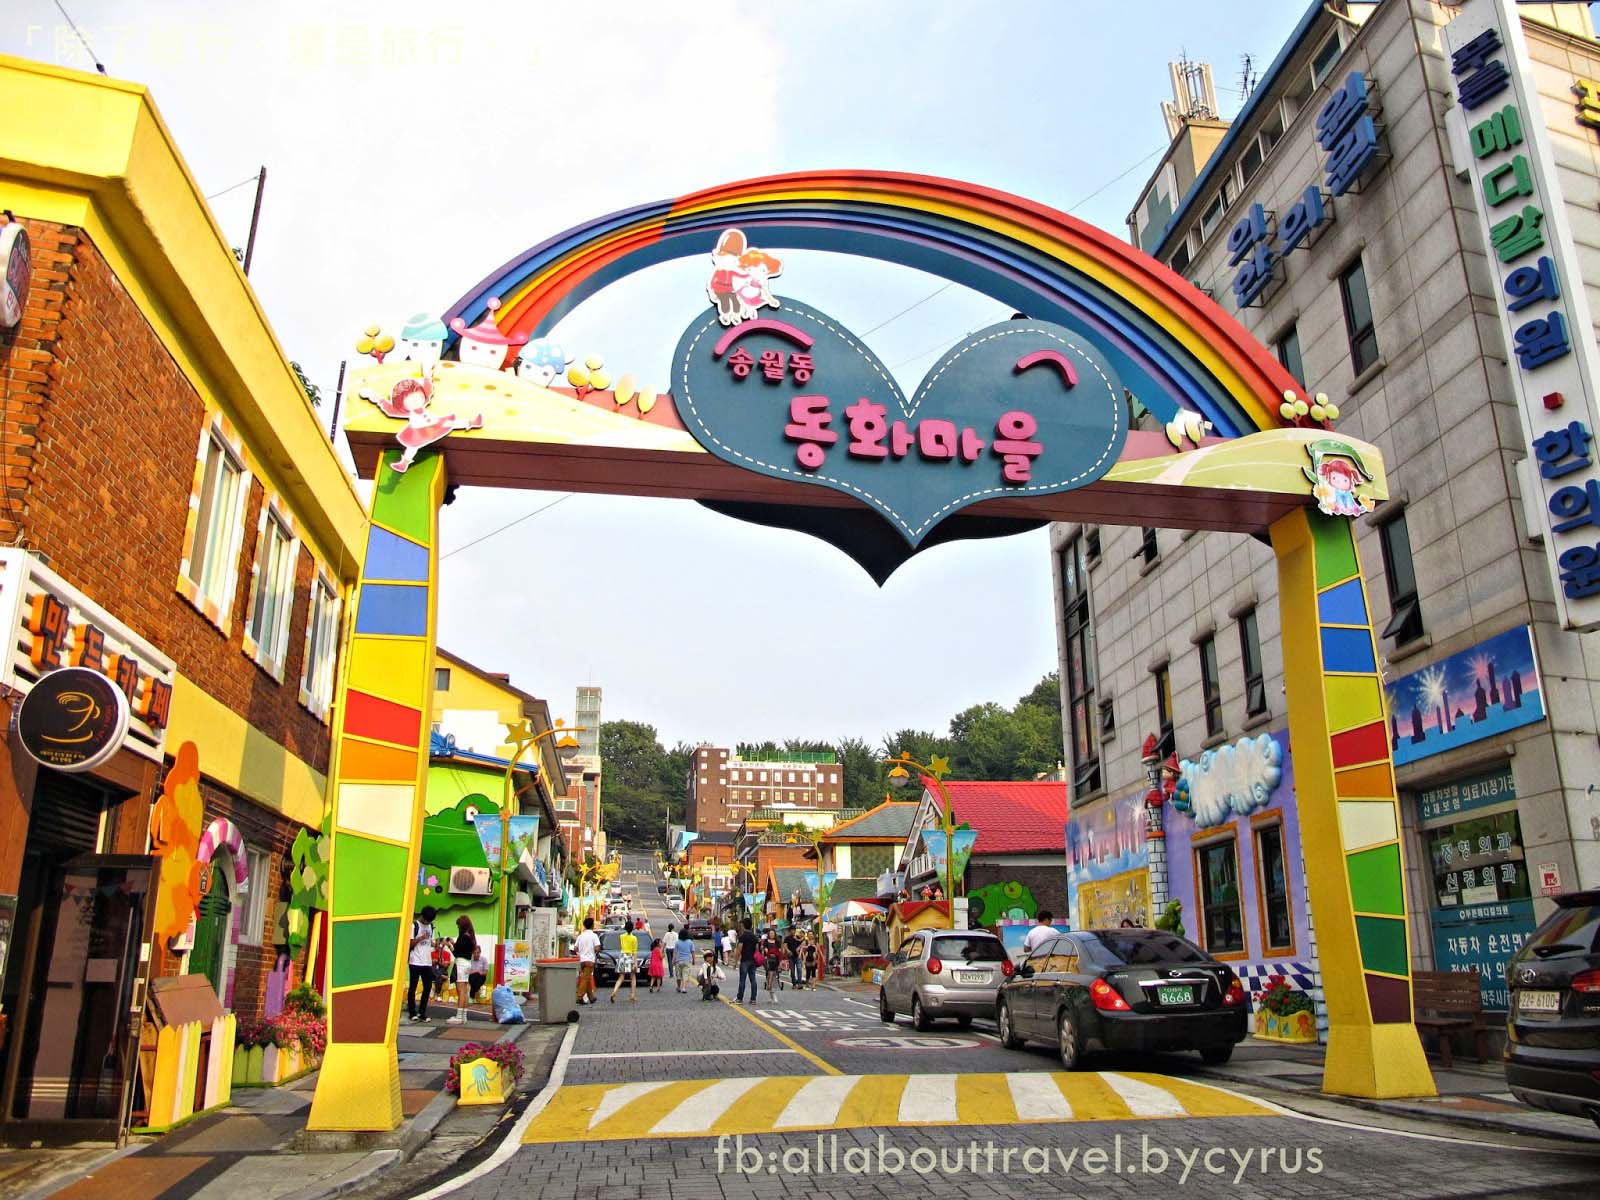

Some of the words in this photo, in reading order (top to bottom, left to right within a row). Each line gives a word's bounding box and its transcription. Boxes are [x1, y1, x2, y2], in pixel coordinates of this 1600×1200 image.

[726, 346, 816, 385] 송월동
[784, 394, 1044, 483] 동화마을
[1447, 935, 1480, 956] 자동차
[1161, 992, 1191, 1003] 8668
